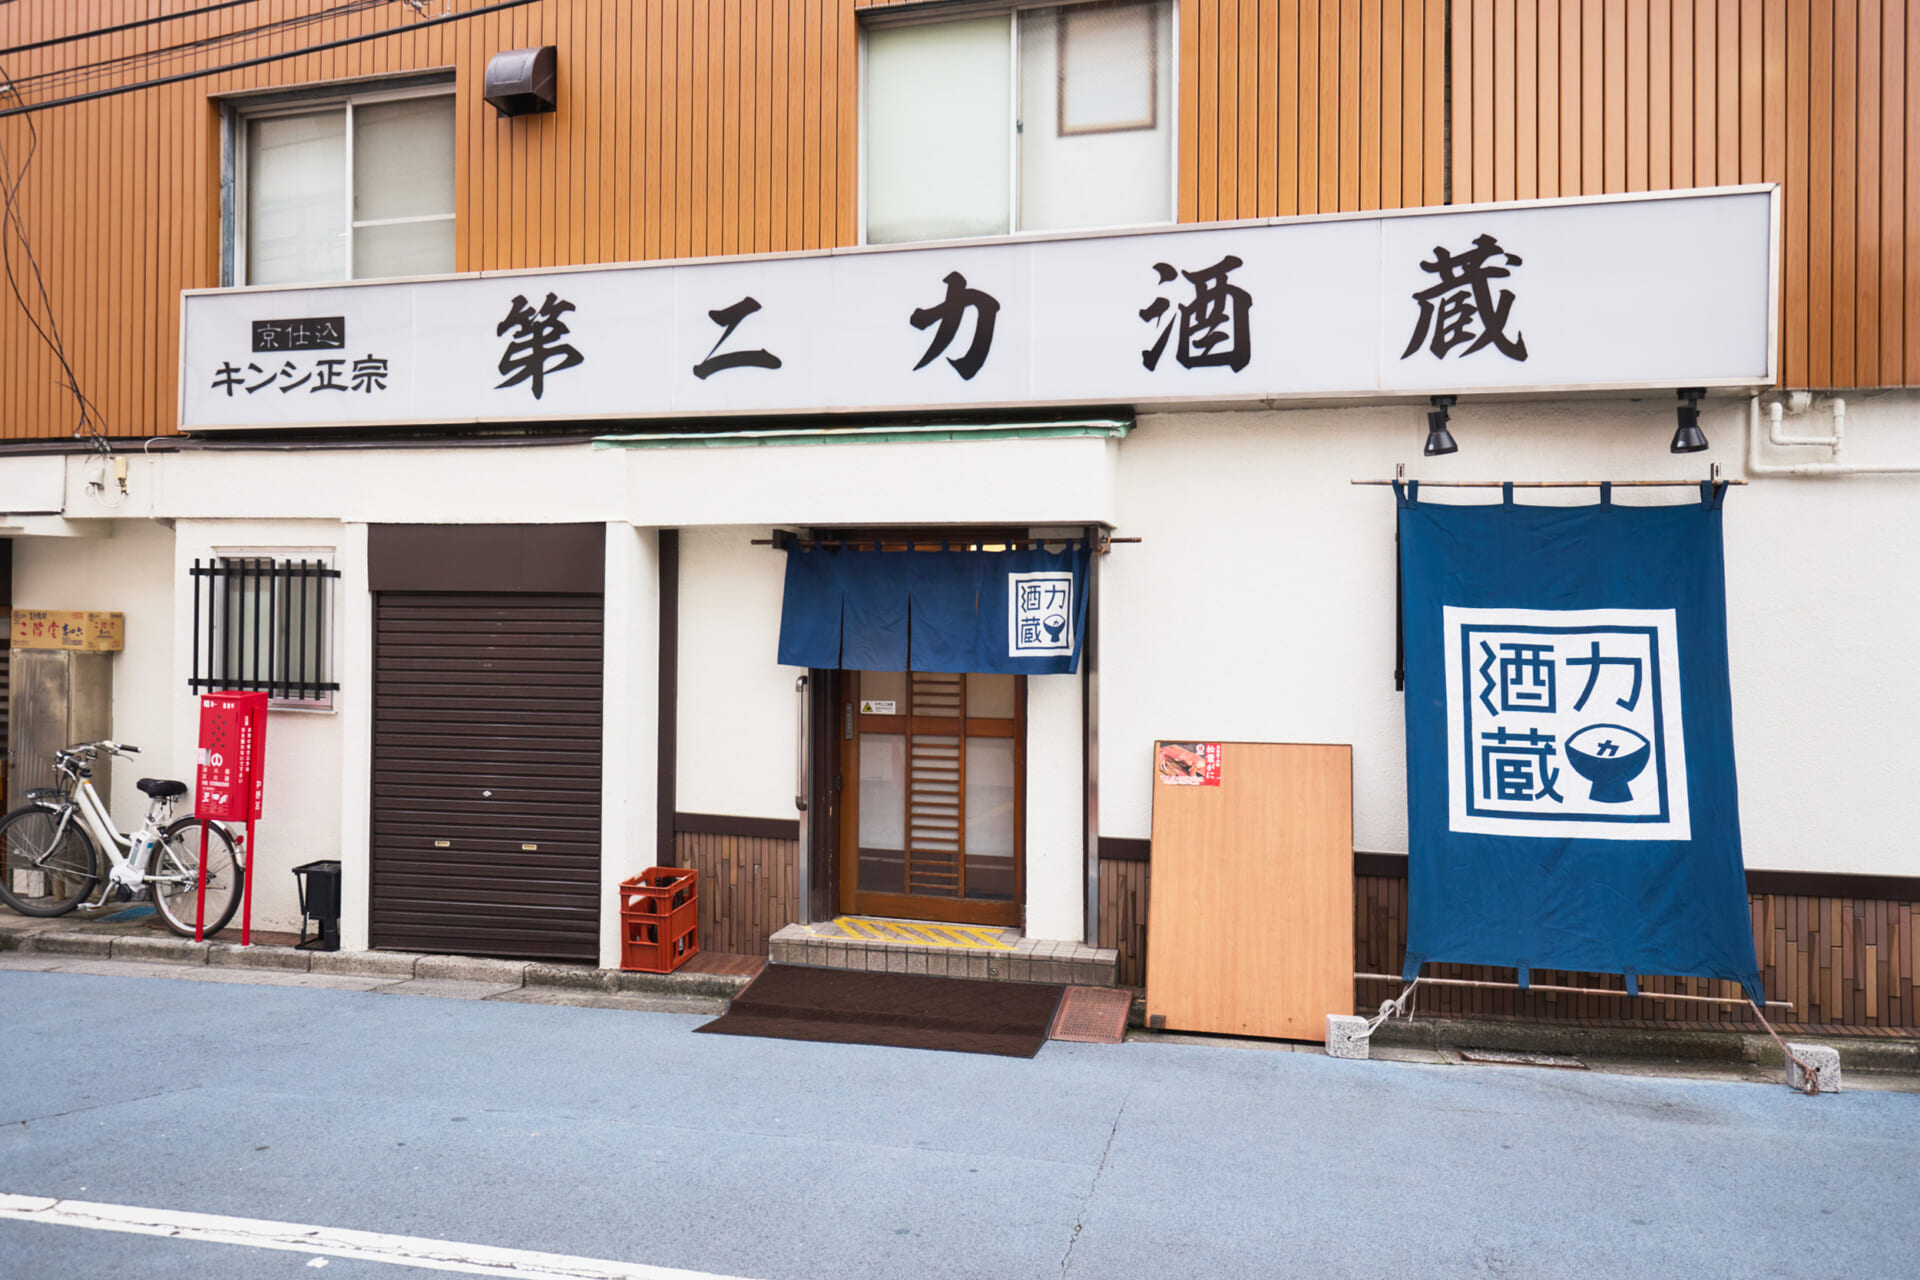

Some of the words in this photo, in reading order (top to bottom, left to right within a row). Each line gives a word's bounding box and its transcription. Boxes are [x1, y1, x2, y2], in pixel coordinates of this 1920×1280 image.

[257, 322, 341, 349] 京仕込
[496, 234, 1527, 399] 第二力酒蔵
[211, 354, 388, 397] キンシ正宗
